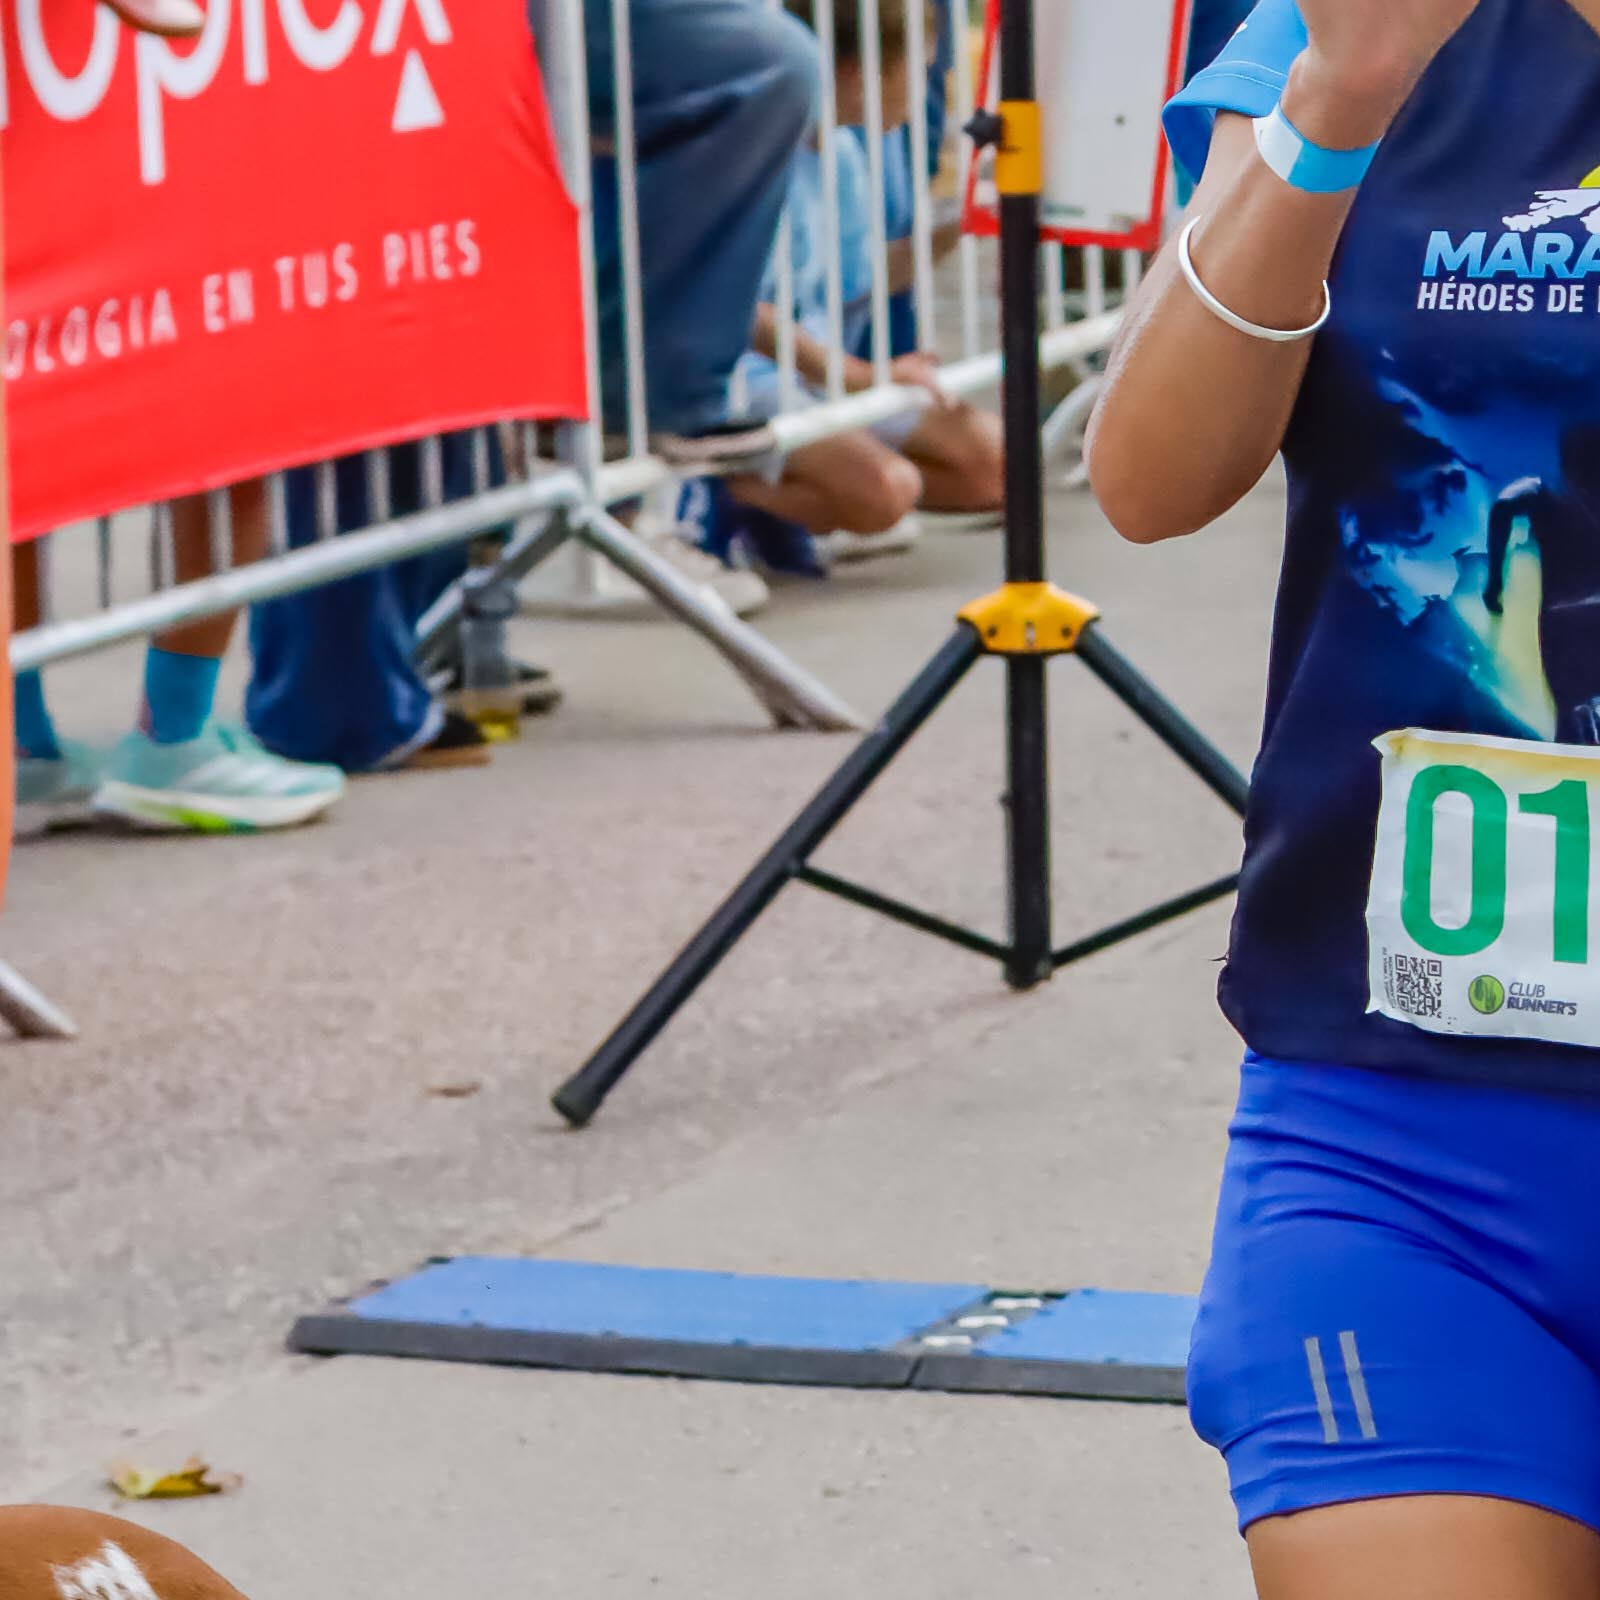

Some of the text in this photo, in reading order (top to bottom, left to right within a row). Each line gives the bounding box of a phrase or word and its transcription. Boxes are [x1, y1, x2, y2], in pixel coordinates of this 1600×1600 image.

[0, 219, 481, 381] OLOGIA EN TUS PIES
[1417, 276, 1534, 313] HÉROES
[1547, 284, 1584, 313] DE
[1509, 982, 1545, 998] CLUB
